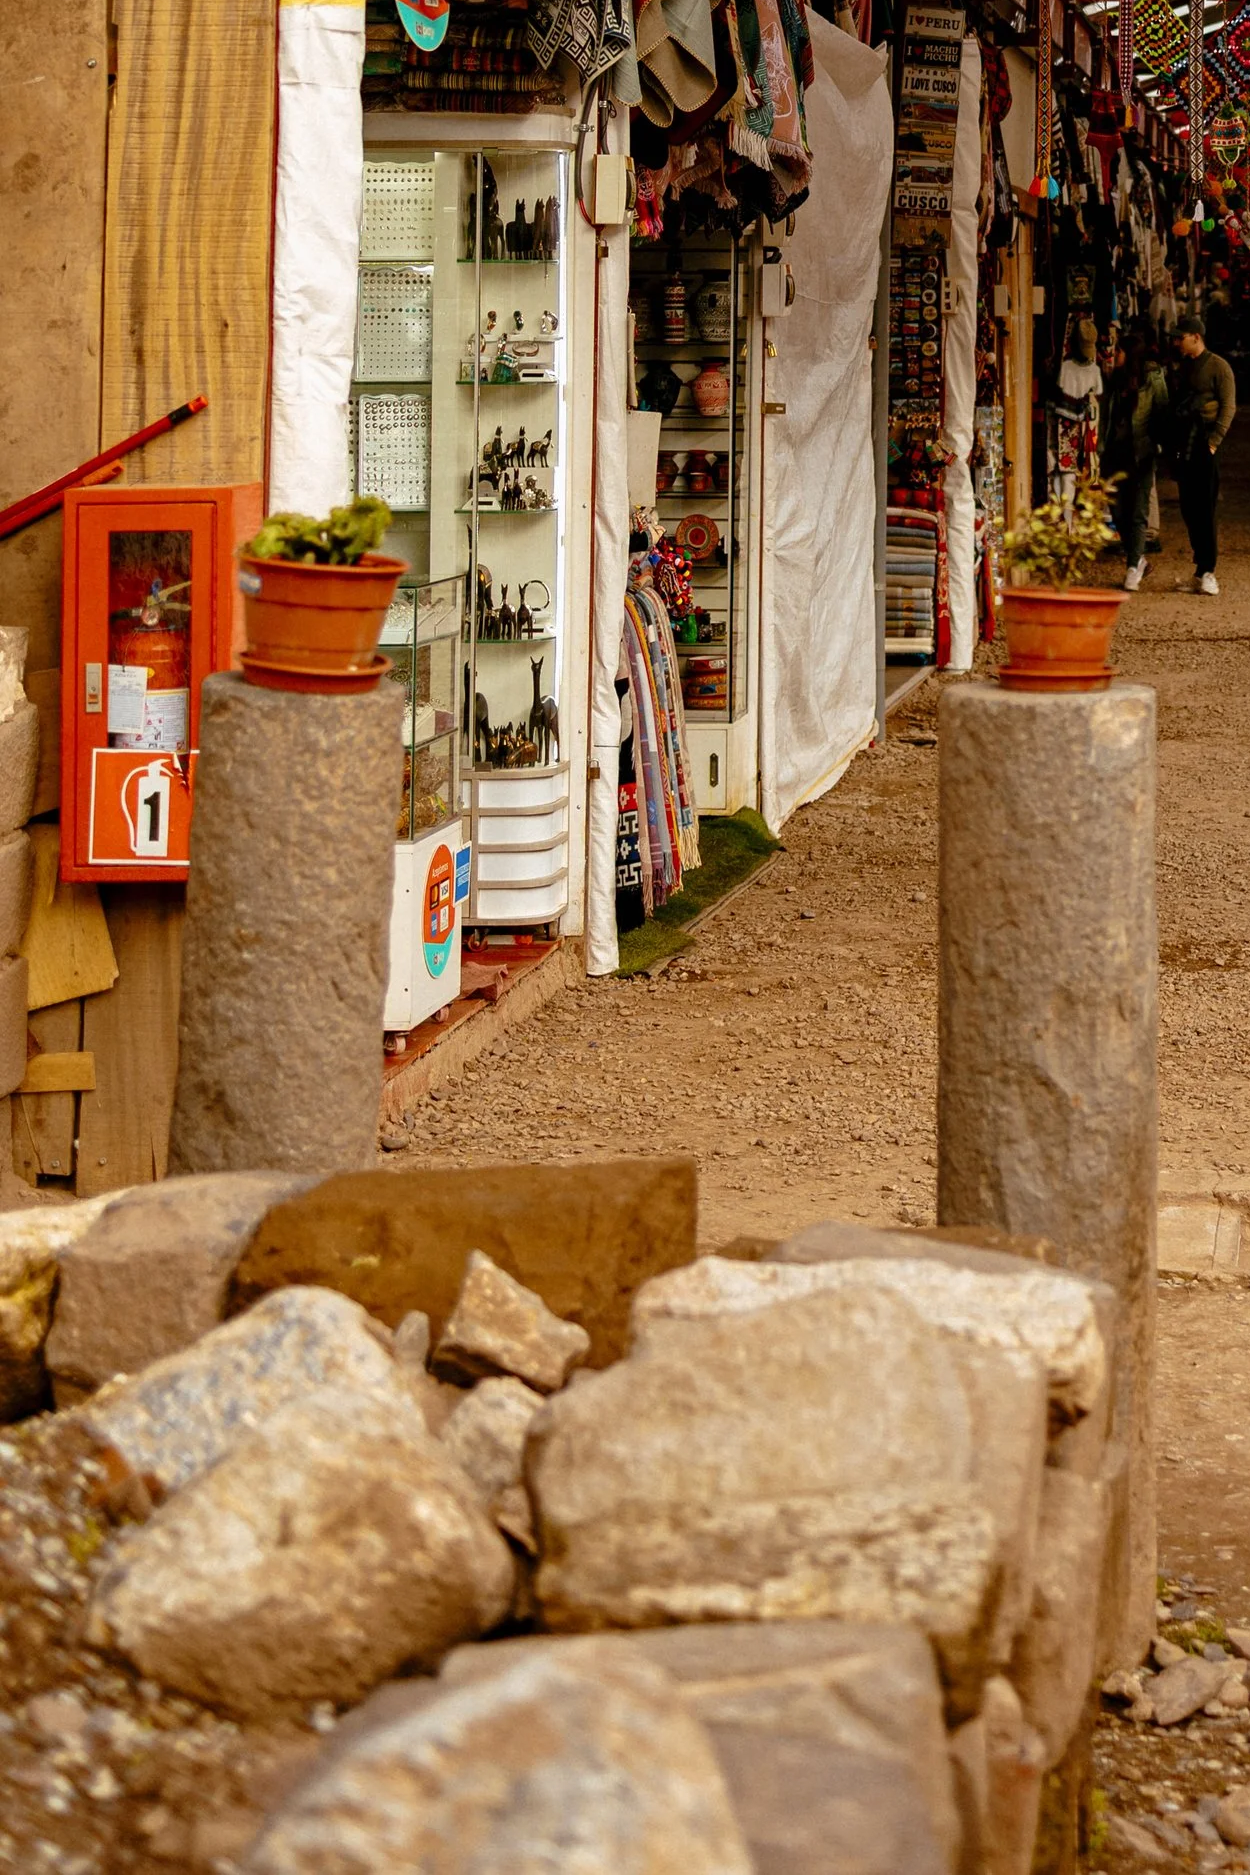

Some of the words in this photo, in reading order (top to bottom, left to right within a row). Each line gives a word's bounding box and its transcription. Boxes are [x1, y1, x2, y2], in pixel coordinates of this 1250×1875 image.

[925, 17, 960, 30] PERU
[925, 45, 959, 54] MACHU
[924, 53, 959, 62] PICCHU
[911, 77, 930, 91] LOVE
[924, 138, 953, 149] CUSCO
[143, 791, 161, 842] 1
